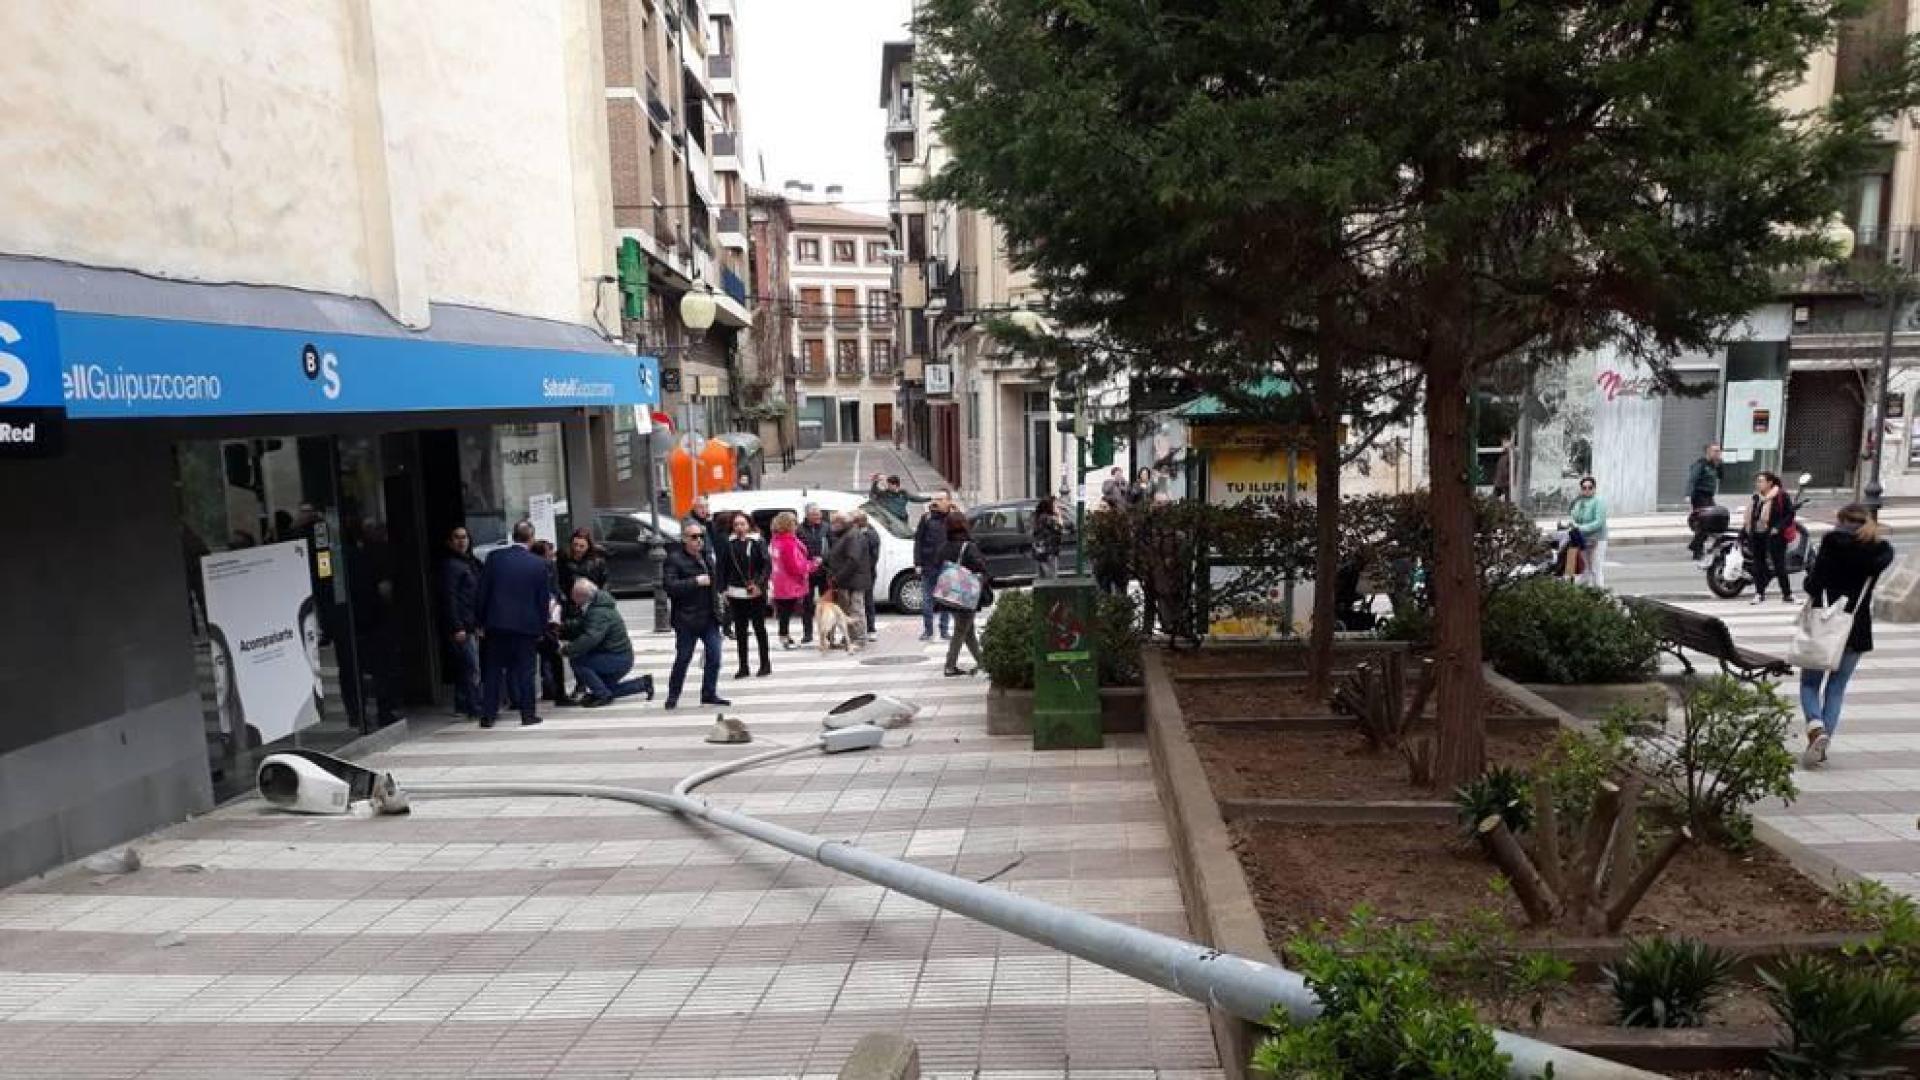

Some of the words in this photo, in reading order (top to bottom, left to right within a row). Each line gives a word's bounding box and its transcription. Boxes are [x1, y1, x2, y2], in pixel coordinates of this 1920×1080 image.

[323, 352, 341, 400] S
[1226, 482, 1244, 493] TU
[1248, 482, 1308, 493] ILUSIN
